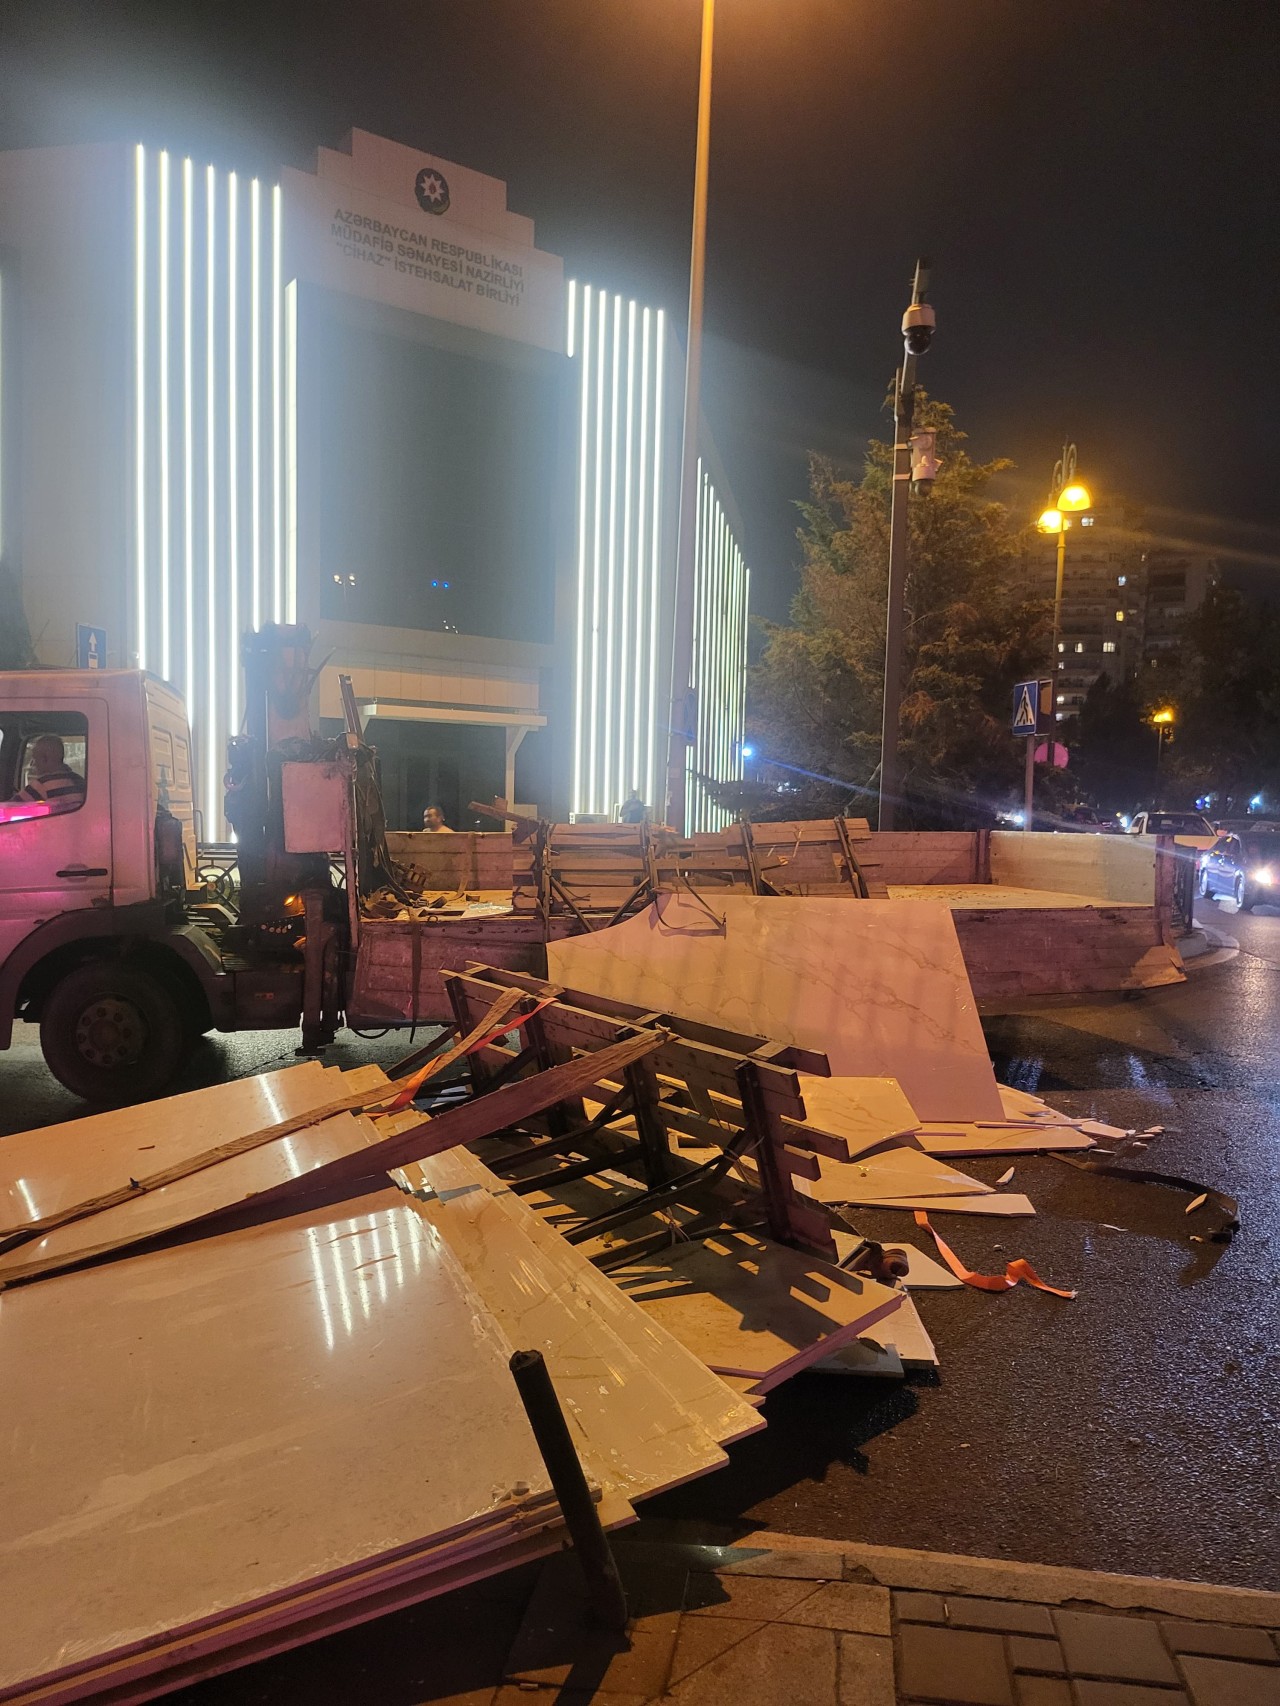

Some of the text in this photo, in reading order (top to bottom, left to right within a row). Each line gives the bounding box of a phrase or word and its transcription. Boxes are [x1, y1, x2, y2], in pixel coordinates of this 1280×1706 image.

[331, 223, 524, 293] MÜDAFİƏ SƏNAYESİ NAZİRLİYİ
[334, 208, 523, 277] AZƏRBAYCAN RESPUBLİKASI
[394, 256, 473, 293] İSTEHSALAT
[476, 283, 520, 307] BİRLİYİ
